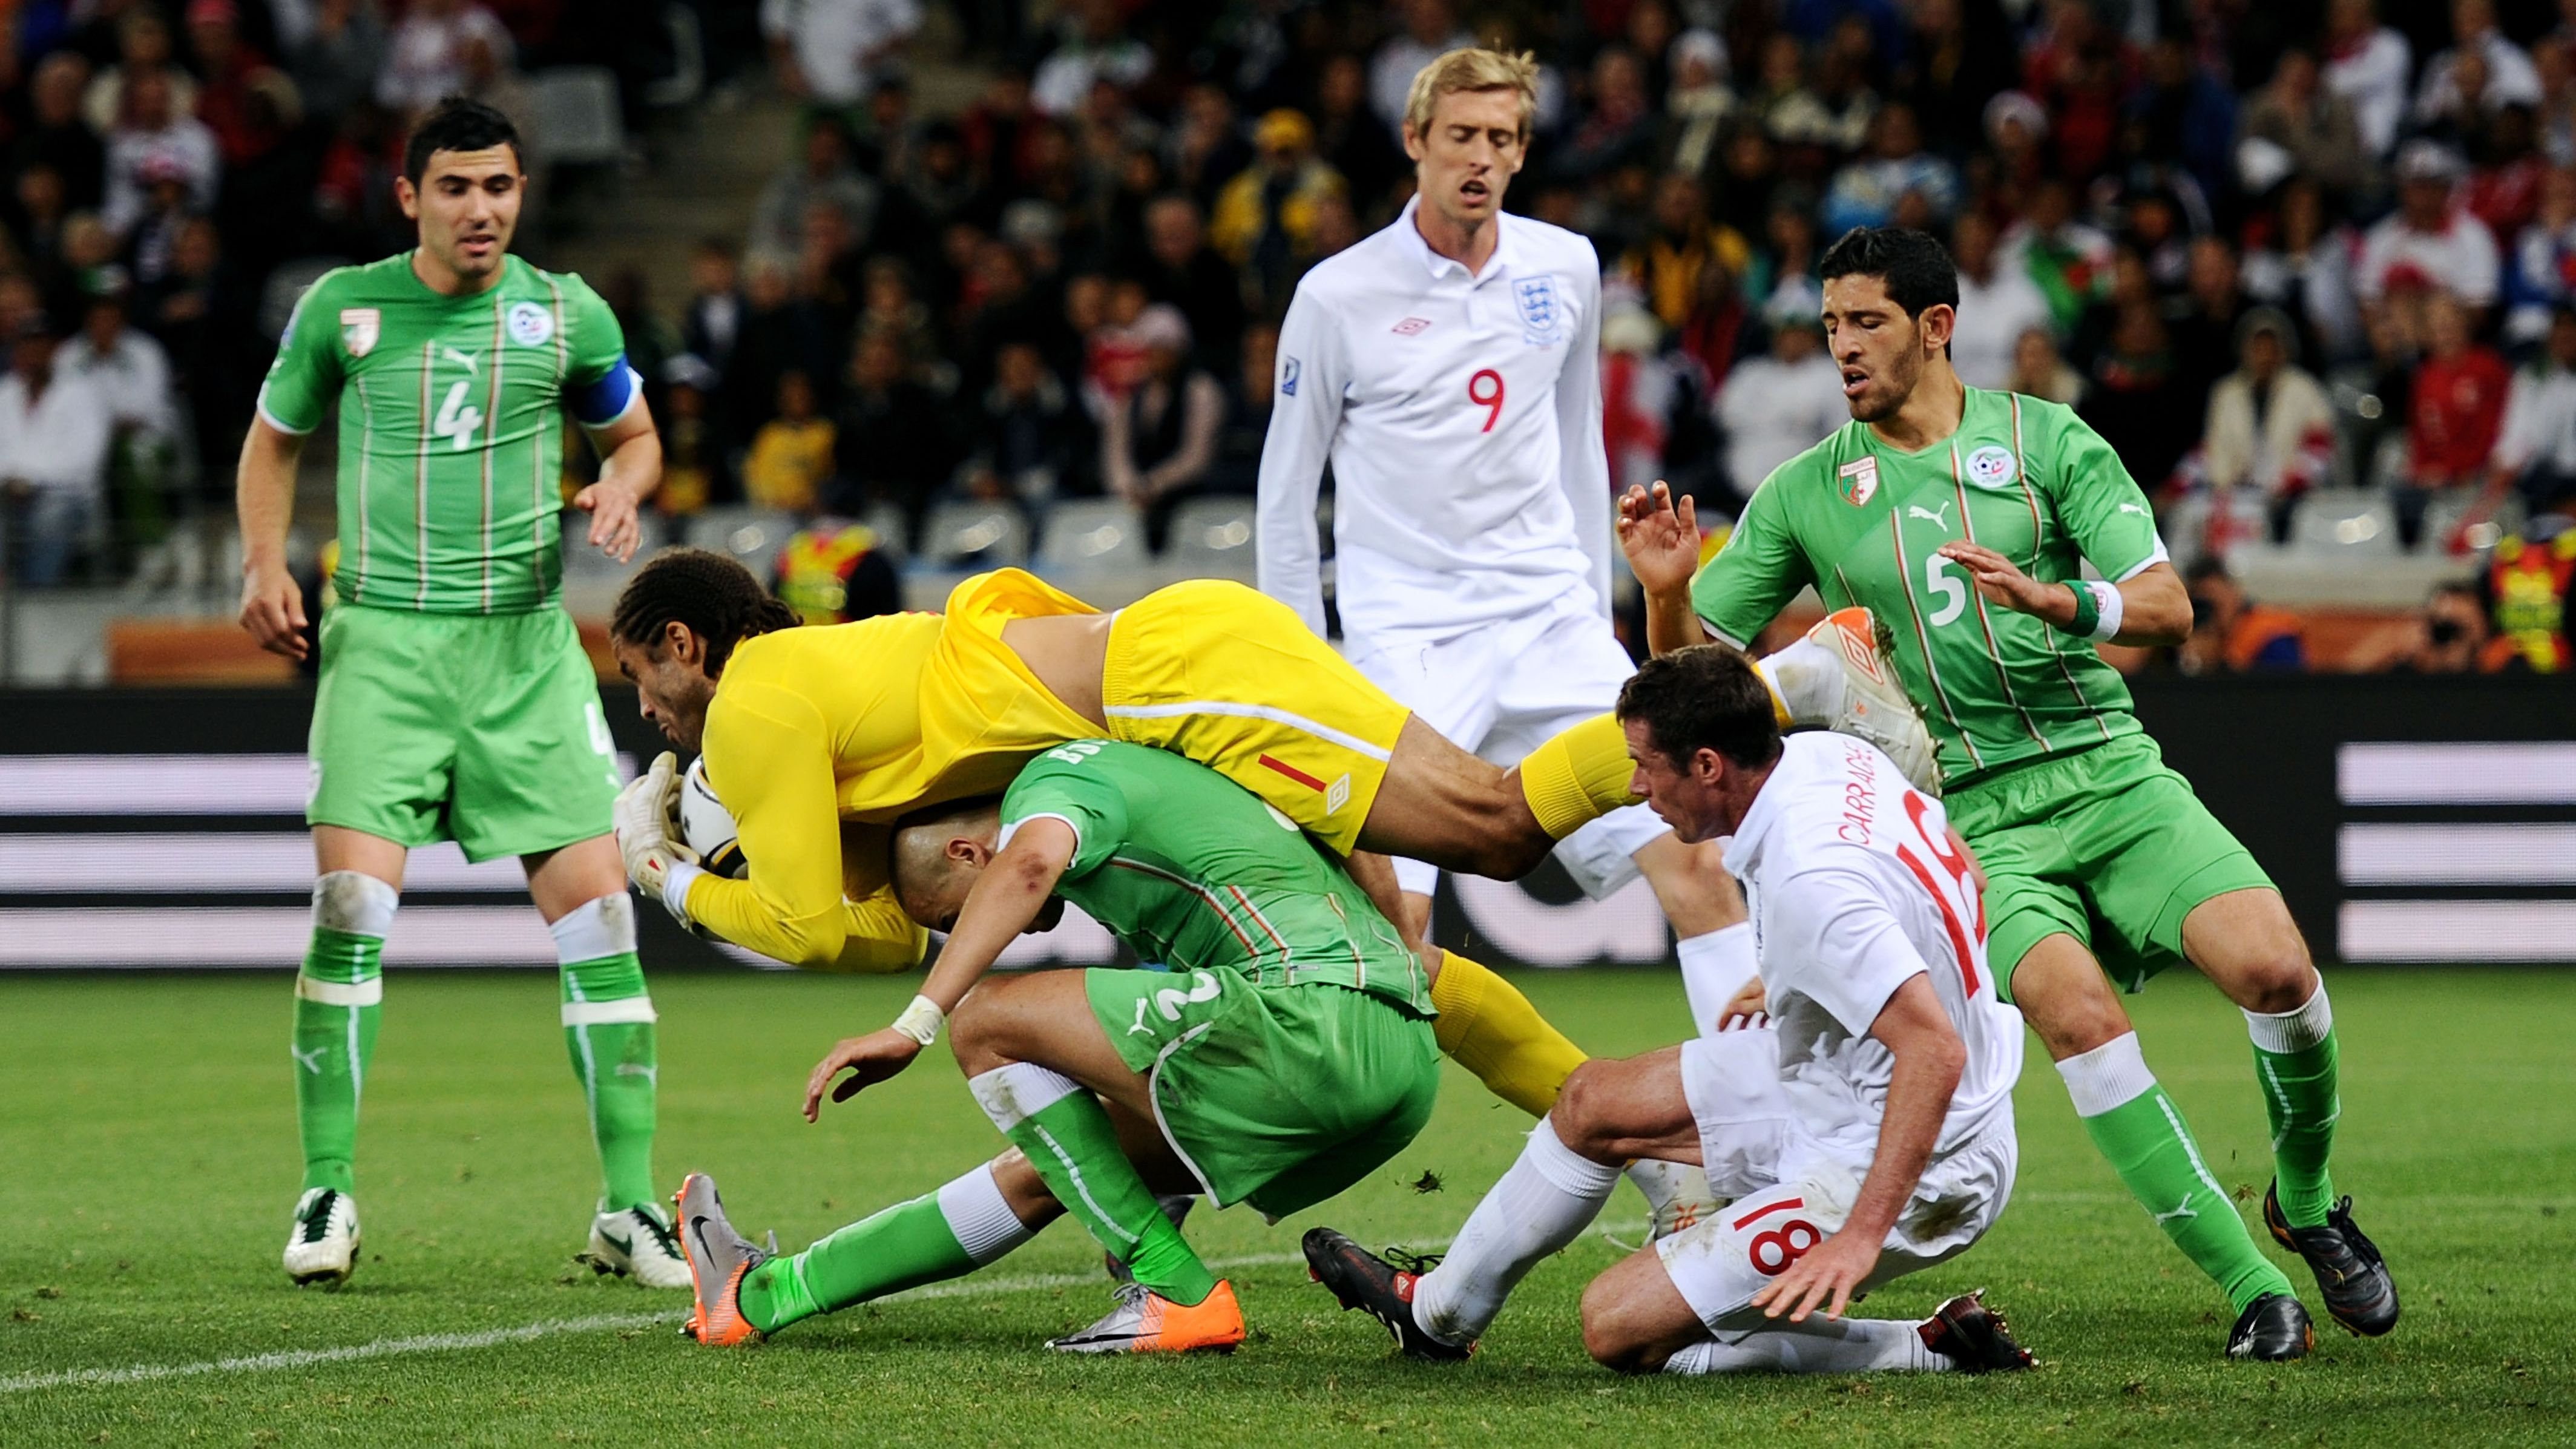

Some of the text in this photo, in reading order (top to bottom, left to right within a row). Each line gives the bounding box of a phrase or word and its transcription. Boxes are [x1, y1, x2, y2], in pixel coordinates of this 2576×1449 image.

[434, 381, 484, 450] 4
[1468, 369, 1505, 432] 9
[1925, 550, 1966, 627] 5
[1258, 754, 1327, 793] 1
[1156, 971, 1221, 1021] 2
[1732, 1197, 1822, 1276] 18
